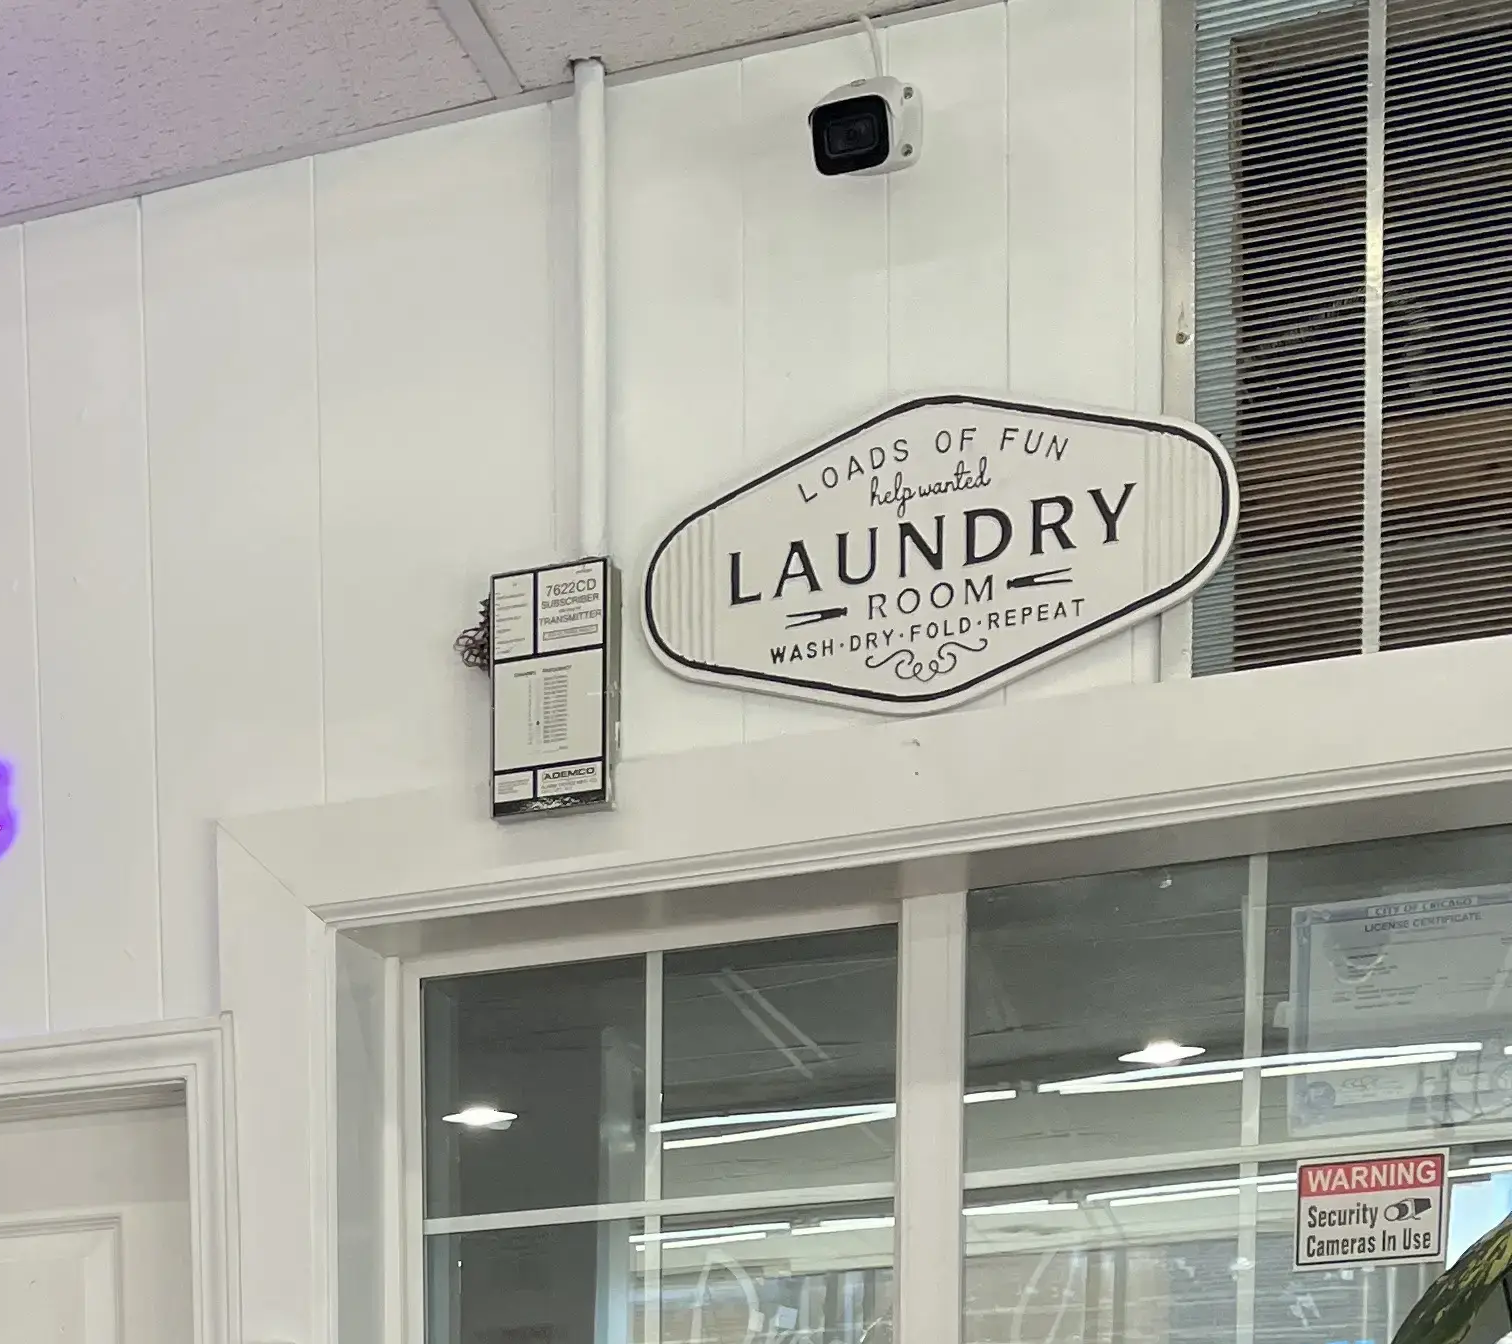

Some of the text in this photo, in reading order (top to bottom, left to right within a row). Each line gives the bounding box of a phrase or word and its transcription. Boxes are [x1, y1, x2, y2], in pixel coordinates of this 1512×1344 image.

[798, 427, 1069, 503] LOADS OF FUN
[870, 457, 991, 516] help wanted
[729, 482, 1136, 606] LAUNDRY
[546, 578, 596, 596] 7622CD
[867, 574, 994, 620] ROOM
[539, 609, 602, 626] TRANSMITTER
[1365, 912, 1482, 932] LICENSE CERTIFICATE
[1308, 1159, 1437, 1192] WARNING
[1308, 1203, 1378, 1230] Security
[1307, 1227, 1431, 1259] Cameras In Use
